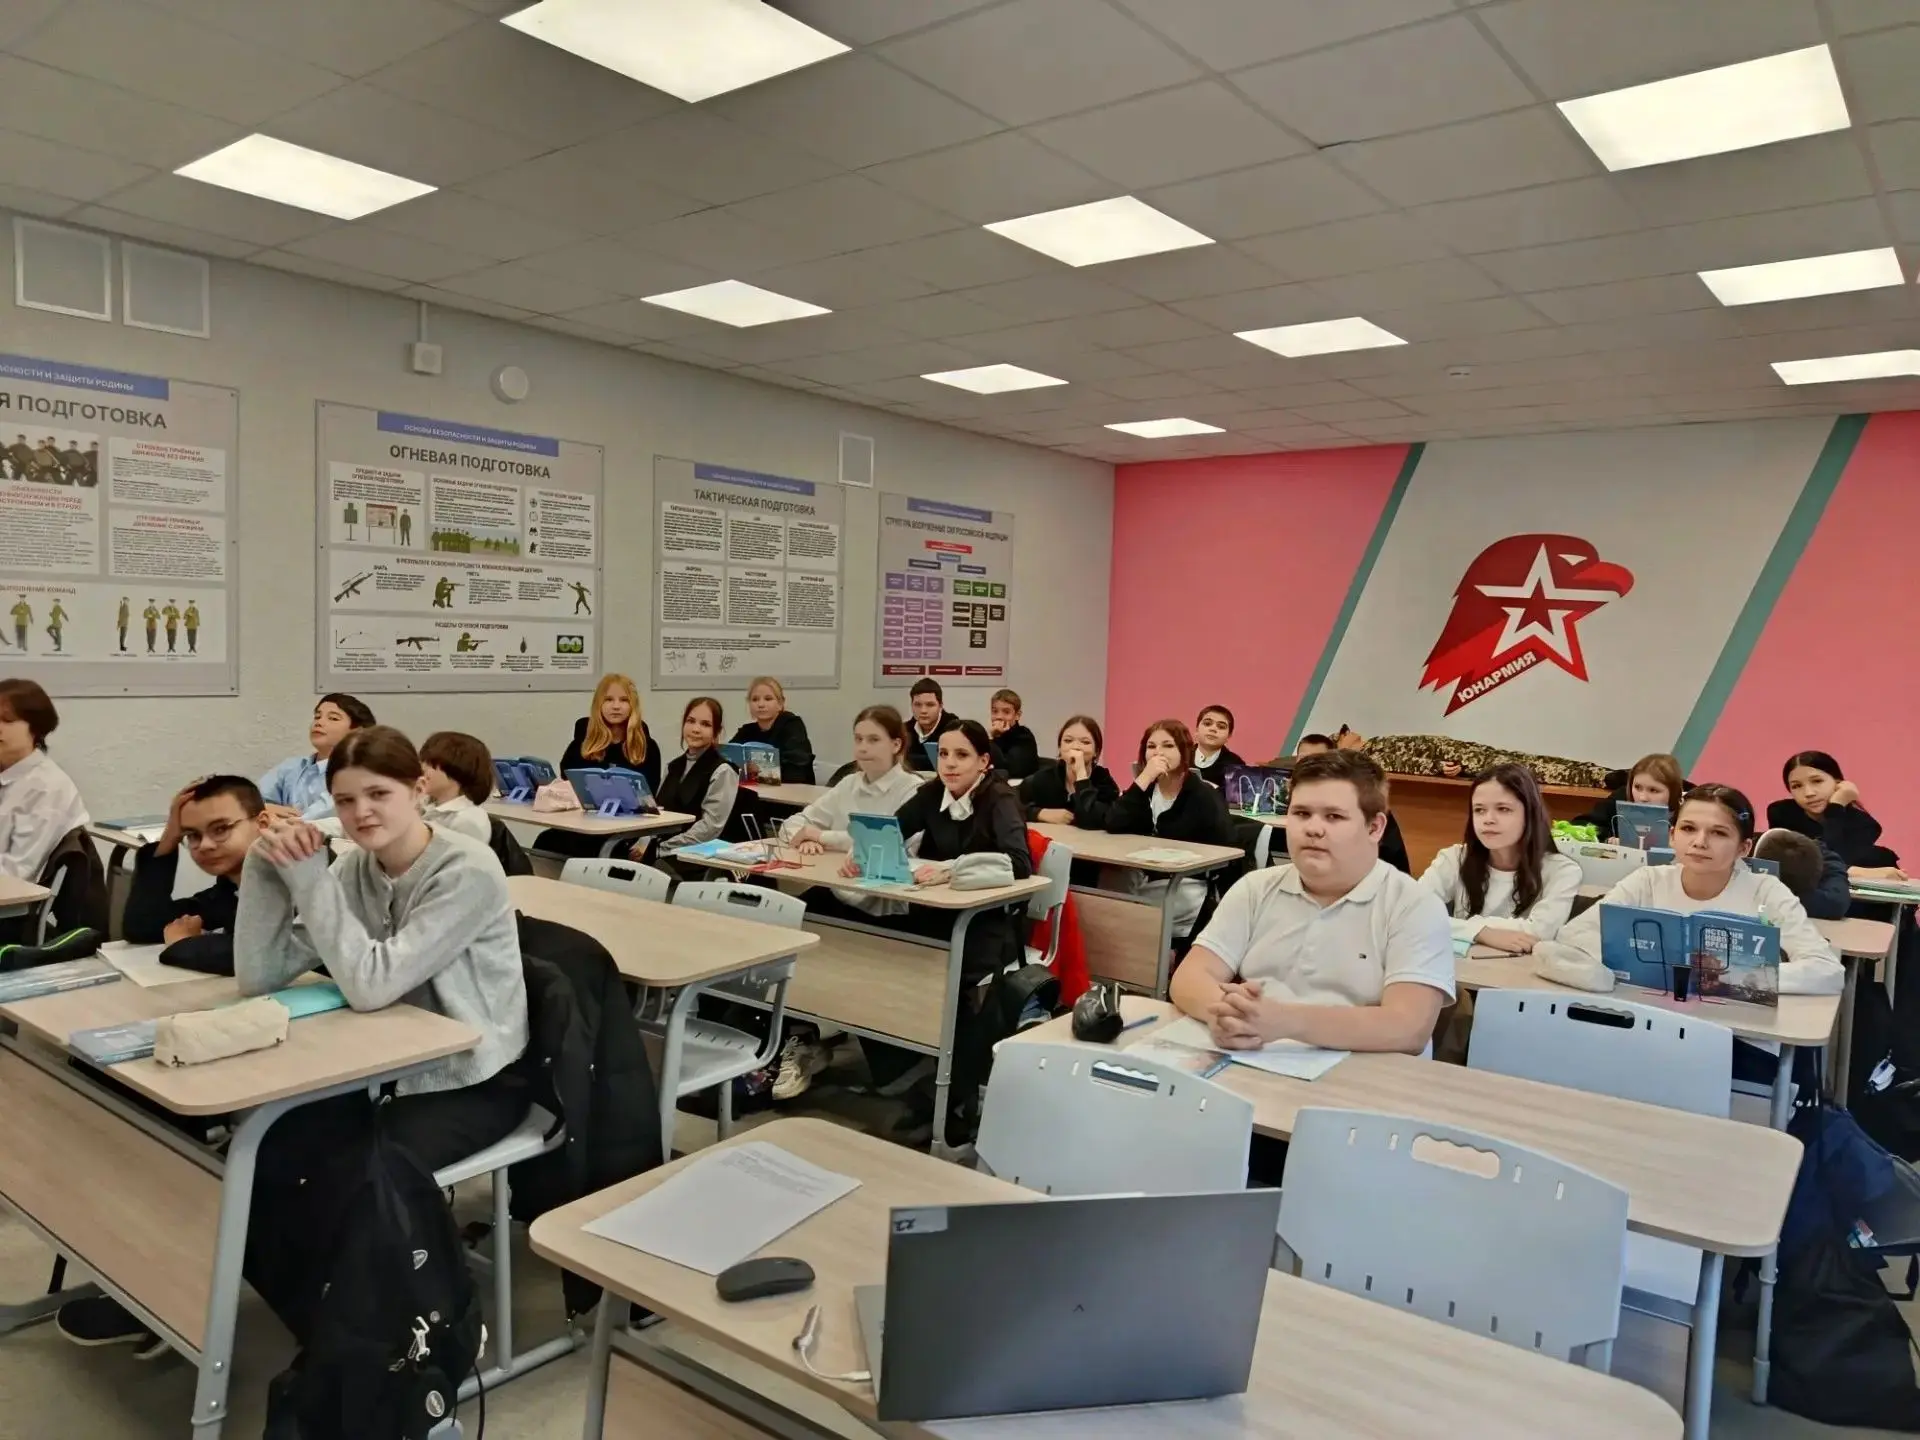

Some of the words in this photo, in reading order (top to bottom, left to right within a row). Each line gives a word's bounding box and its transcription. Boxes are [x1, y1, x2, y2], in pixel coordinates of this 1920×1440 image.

[53, 373, 95, 386] ЗАЩИТЫ
[95, 379, 134, 391] РОДИНЫ
[18, 394, 167, 429] ПОДГОТОВКА
[390, 445, 458, 465] ОГНЕВАЯ
[460, 455, 551, 479] ПОДГОТОВКА
[694, 488, 759, 508] ТАКТИЧЕСКАЯ
[761, 499, 816, 516] ПОДГОТОВКА
[1458, 651, 1537, 702] ЮНАРМИЯ
[1705, 927, 1744, 940] ИСТОИЯ
[1705, 934, 1738, 945] НОВОО
[1649, 941, 1656, 950] 7
[1704, 940, 1744, 952] ВРЕМНИ
[1752, 935, 1766, 955] 7
